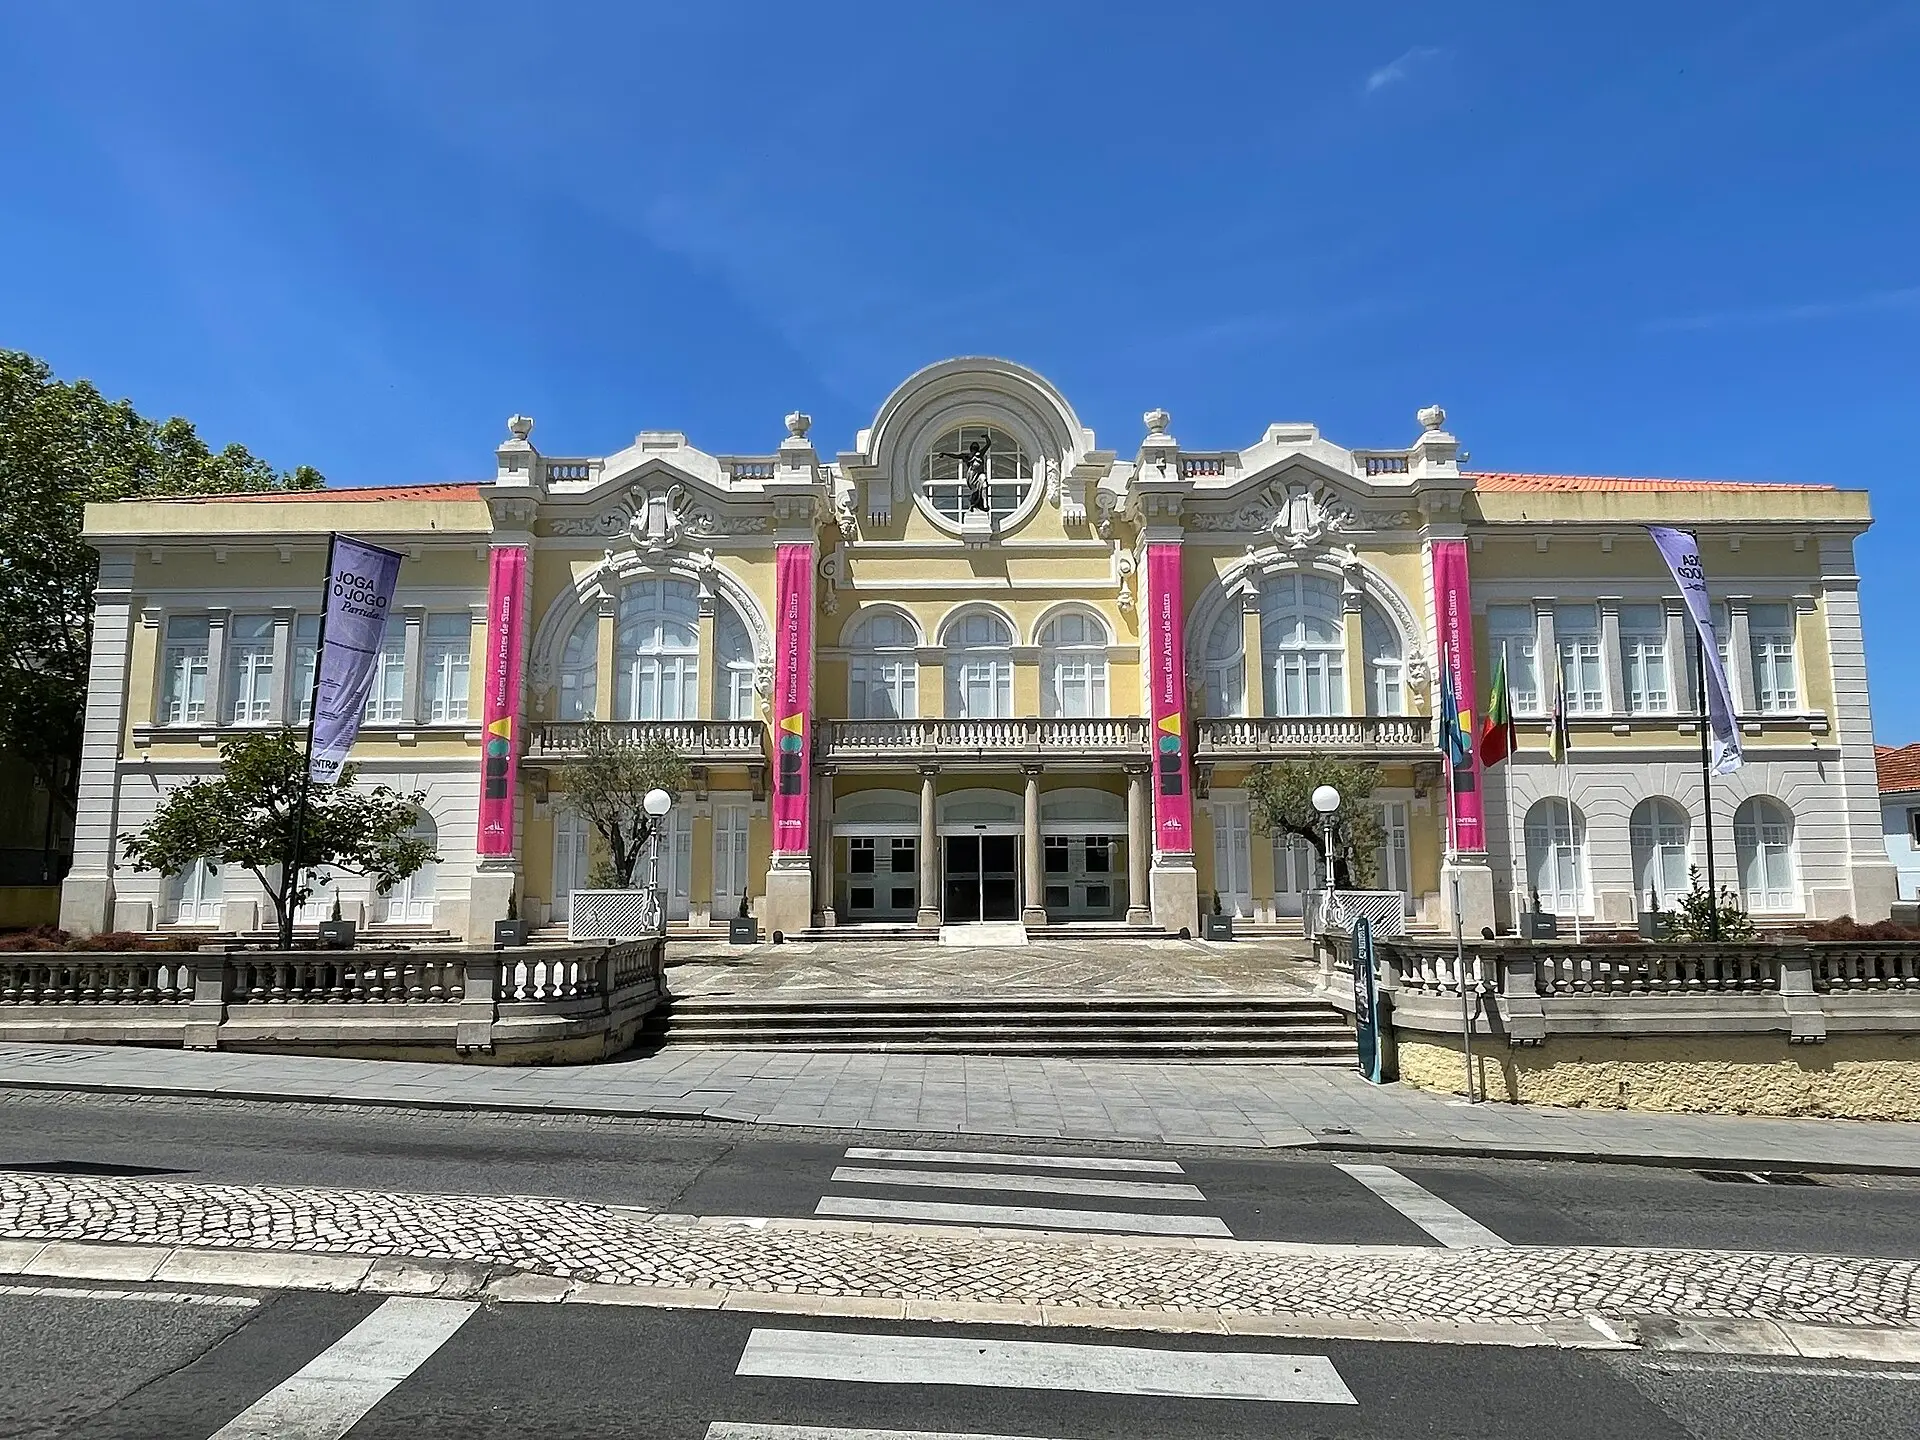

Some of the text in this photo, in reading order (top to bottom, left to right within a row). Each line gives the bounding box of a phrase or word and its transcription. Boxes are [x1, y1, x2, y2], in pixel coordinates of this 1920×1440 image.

[333, 584, 387, 608] O JOGO
[336, 571, 374, 592] JOGA
[496, 595, 511, 707] Museu das Artes de Sintra
[788, 592, 799, 703] Museu das Artes de Sintra
[1162, 592, 1173, 704] Museu das Artes de Sintra
[1448, 589, 1463, 700] Museu das Artes de Sintra
